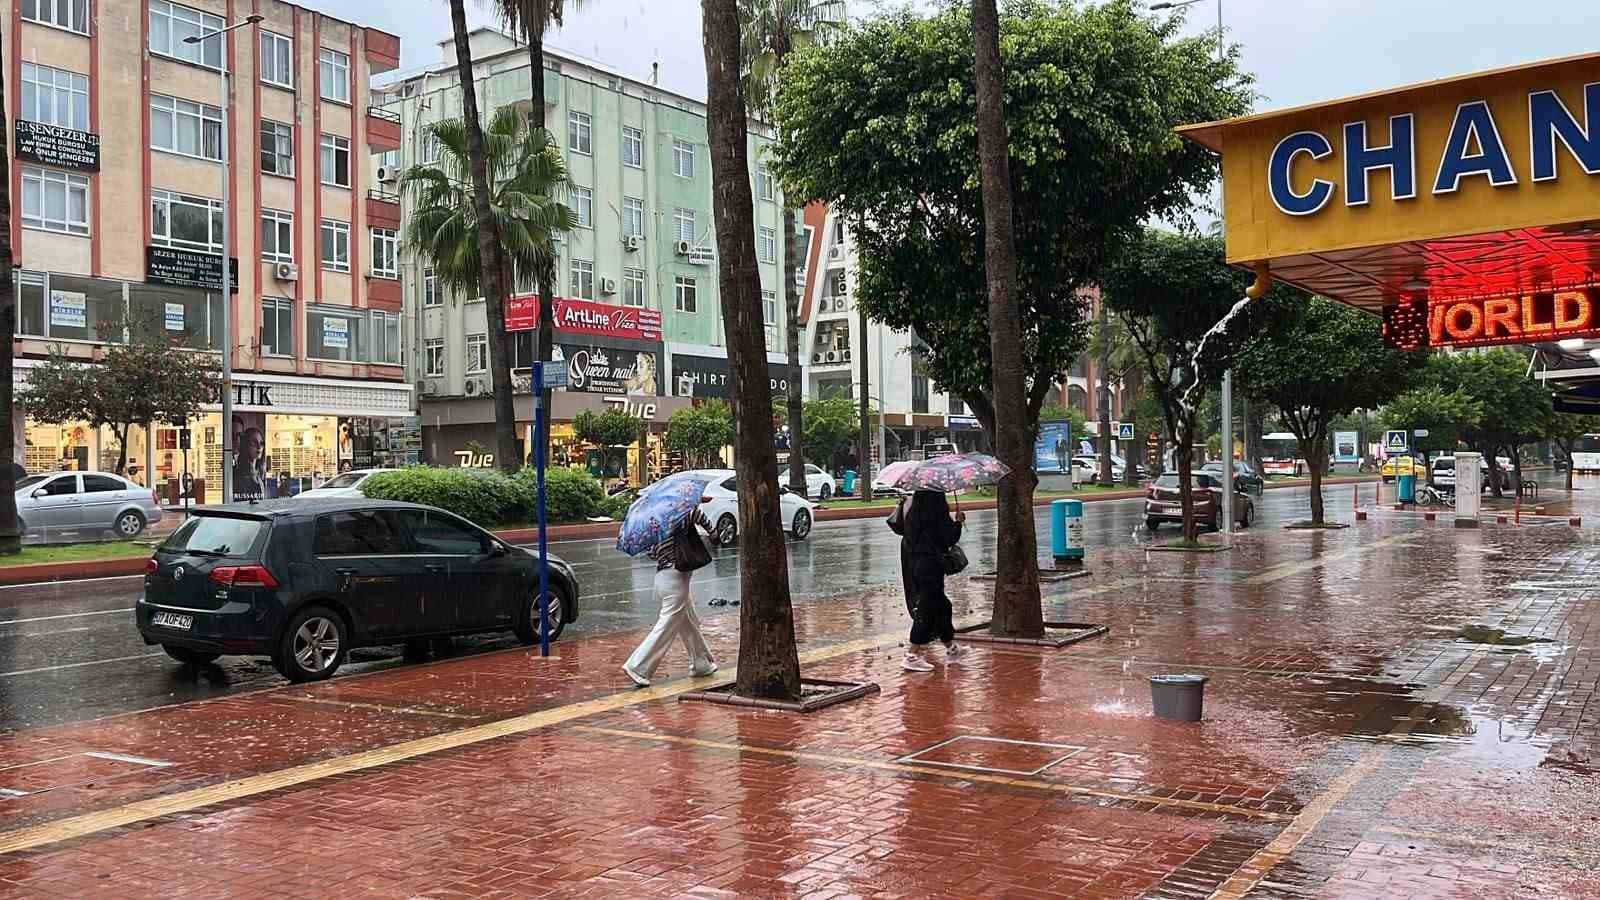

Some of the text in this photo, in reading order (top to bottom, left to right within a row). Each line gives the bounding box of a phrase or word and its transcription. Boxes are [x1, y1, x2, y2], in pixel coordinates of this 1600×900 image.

[32, 134, 56, 144] HUKUK
[35, 148, 57, 157] ONUR
[58, 145, 96, 157] CONSULTING
[1268, 83, 1600, 216] CHAN
[565, 306, 609, 325] ArtLine
[570, 350, 610, 388] Queen
[612, 363, 636, 379] nail
[454, 450, 493, 468] Due
